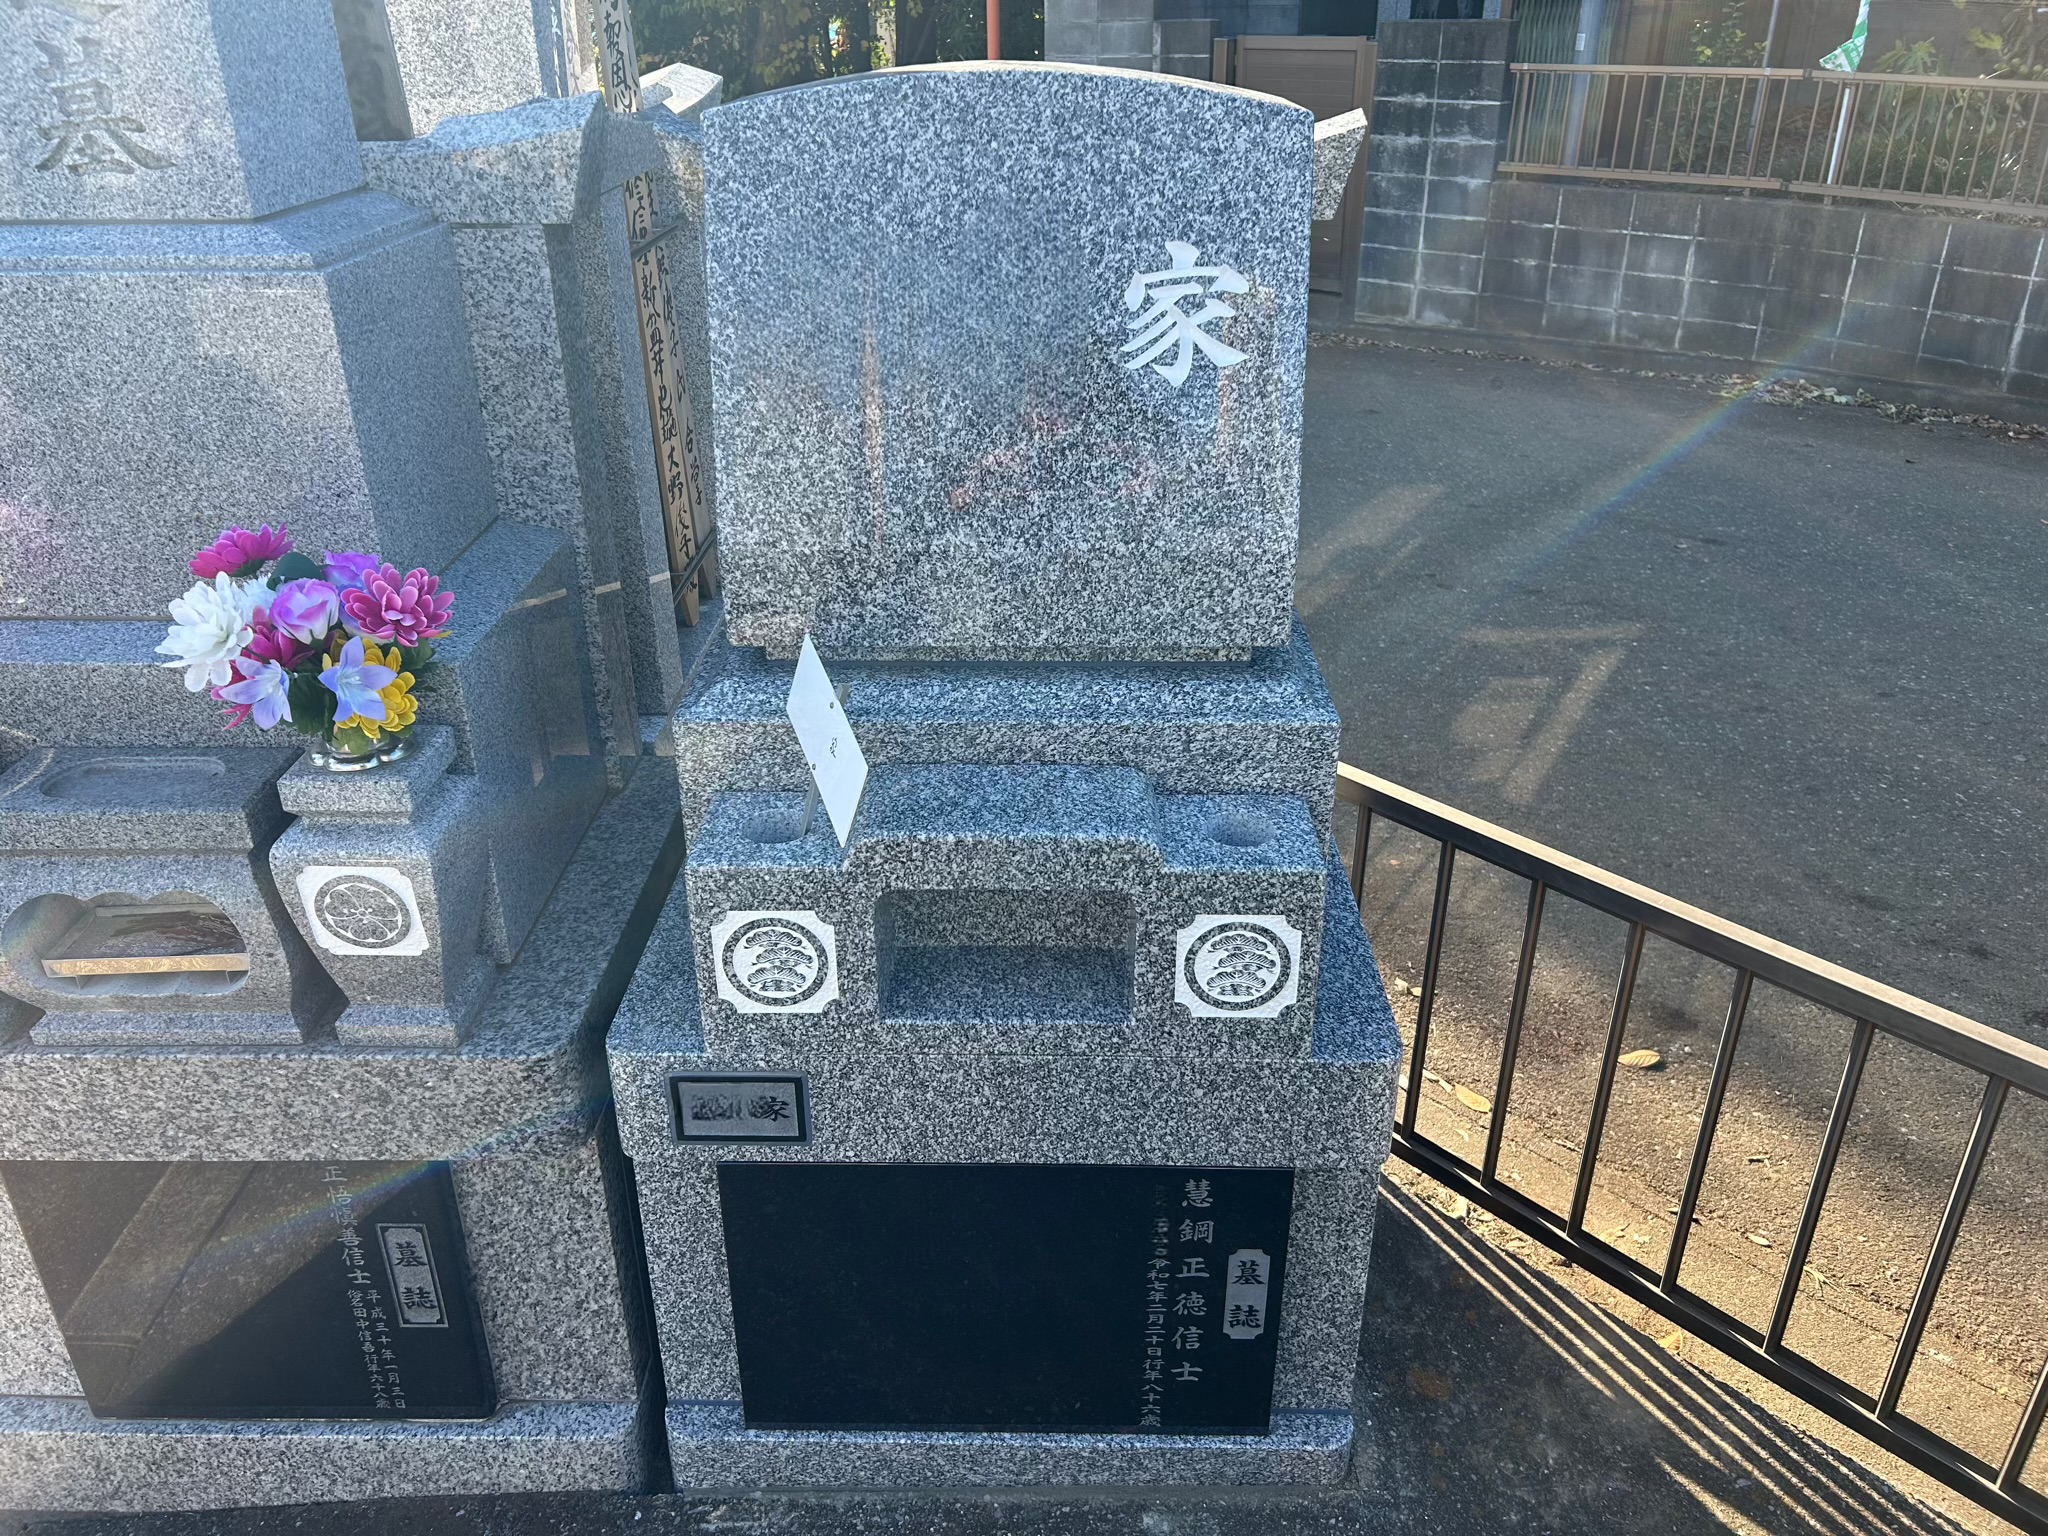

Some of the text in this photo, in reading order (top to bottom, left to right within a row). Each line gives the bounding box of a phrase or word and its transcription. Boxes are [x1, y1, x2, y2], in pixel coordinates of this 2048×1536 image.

[10, 0, 177, 176] 墓
[1119, 240, 1250, 387] 家
[394, 1240, 438, 1310] 墓誌
[1227, 1260, 1266, 1330] 墓誌
